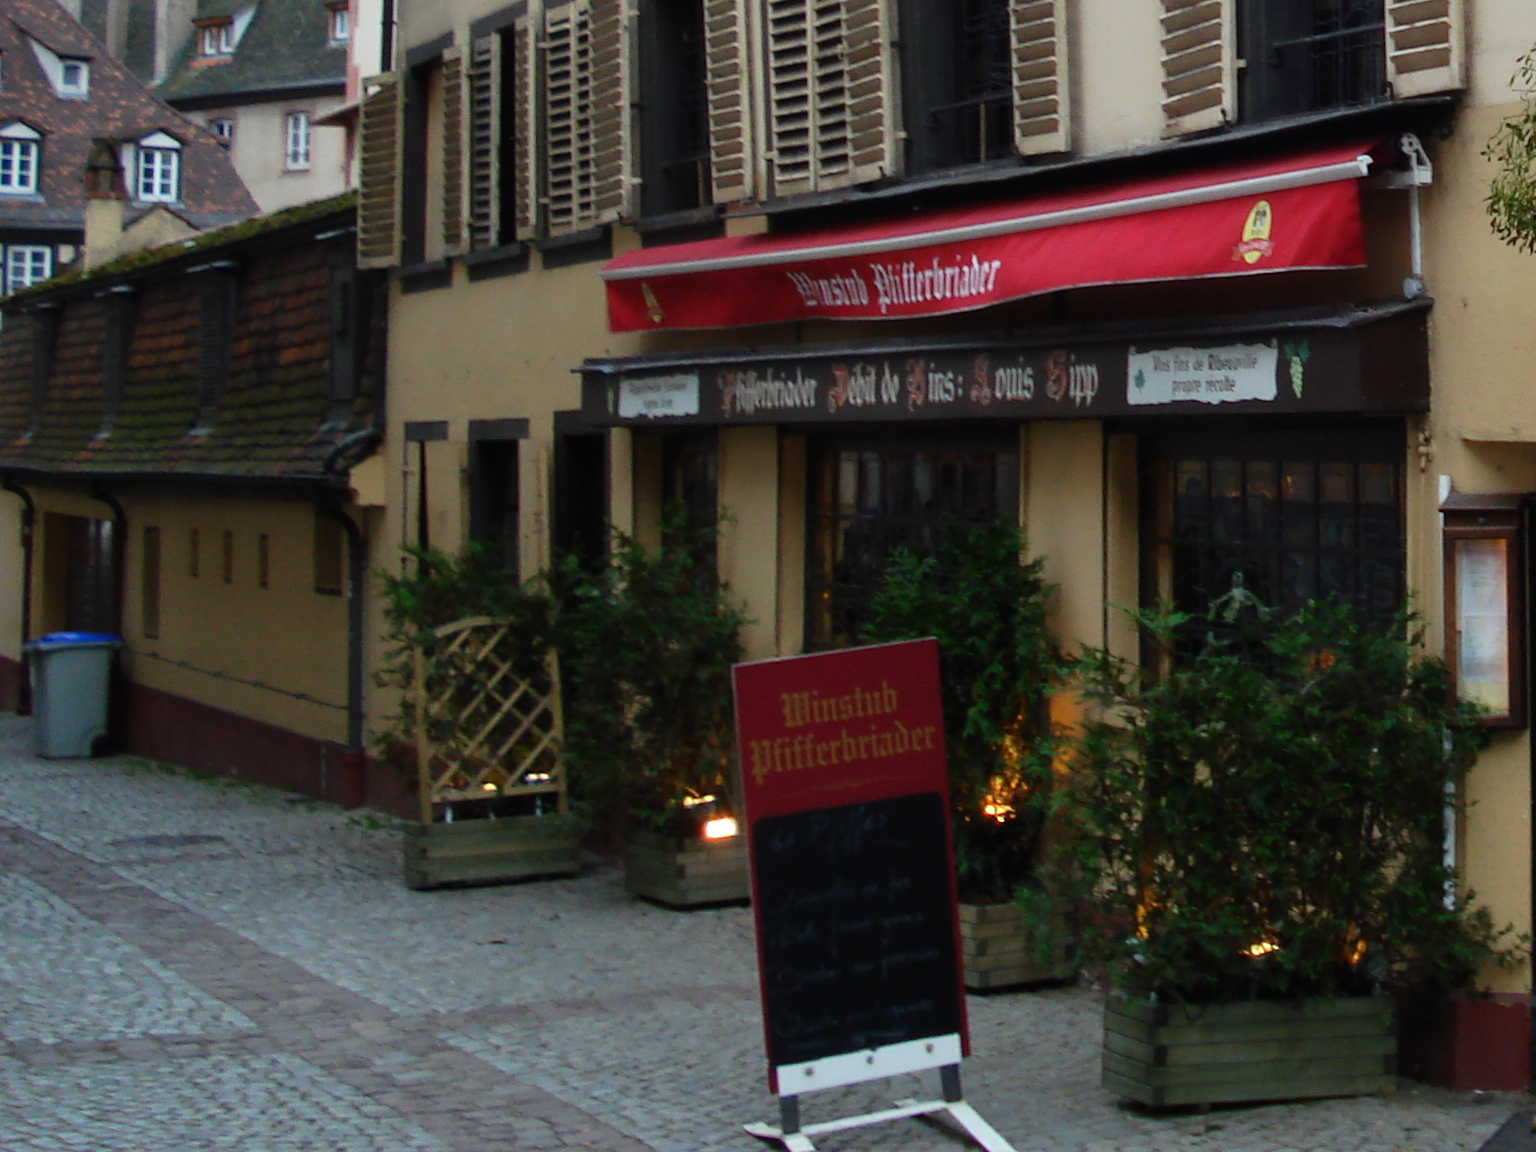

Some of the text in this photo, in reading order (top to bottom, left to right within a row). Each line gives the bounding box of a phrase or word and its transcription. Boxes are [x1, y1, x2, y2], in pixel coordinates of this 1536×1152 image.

[786, 254, 1002, 314] Winstub Pfifferbriader
[881, 360, 900, 405] de
[970, 352, 1035, 406] Louis
[1045, 349, 1099, 408] Sipp
[781, 680, 898, 728] Winstub
[750, 720, 935, 785] Pfifferbriader
